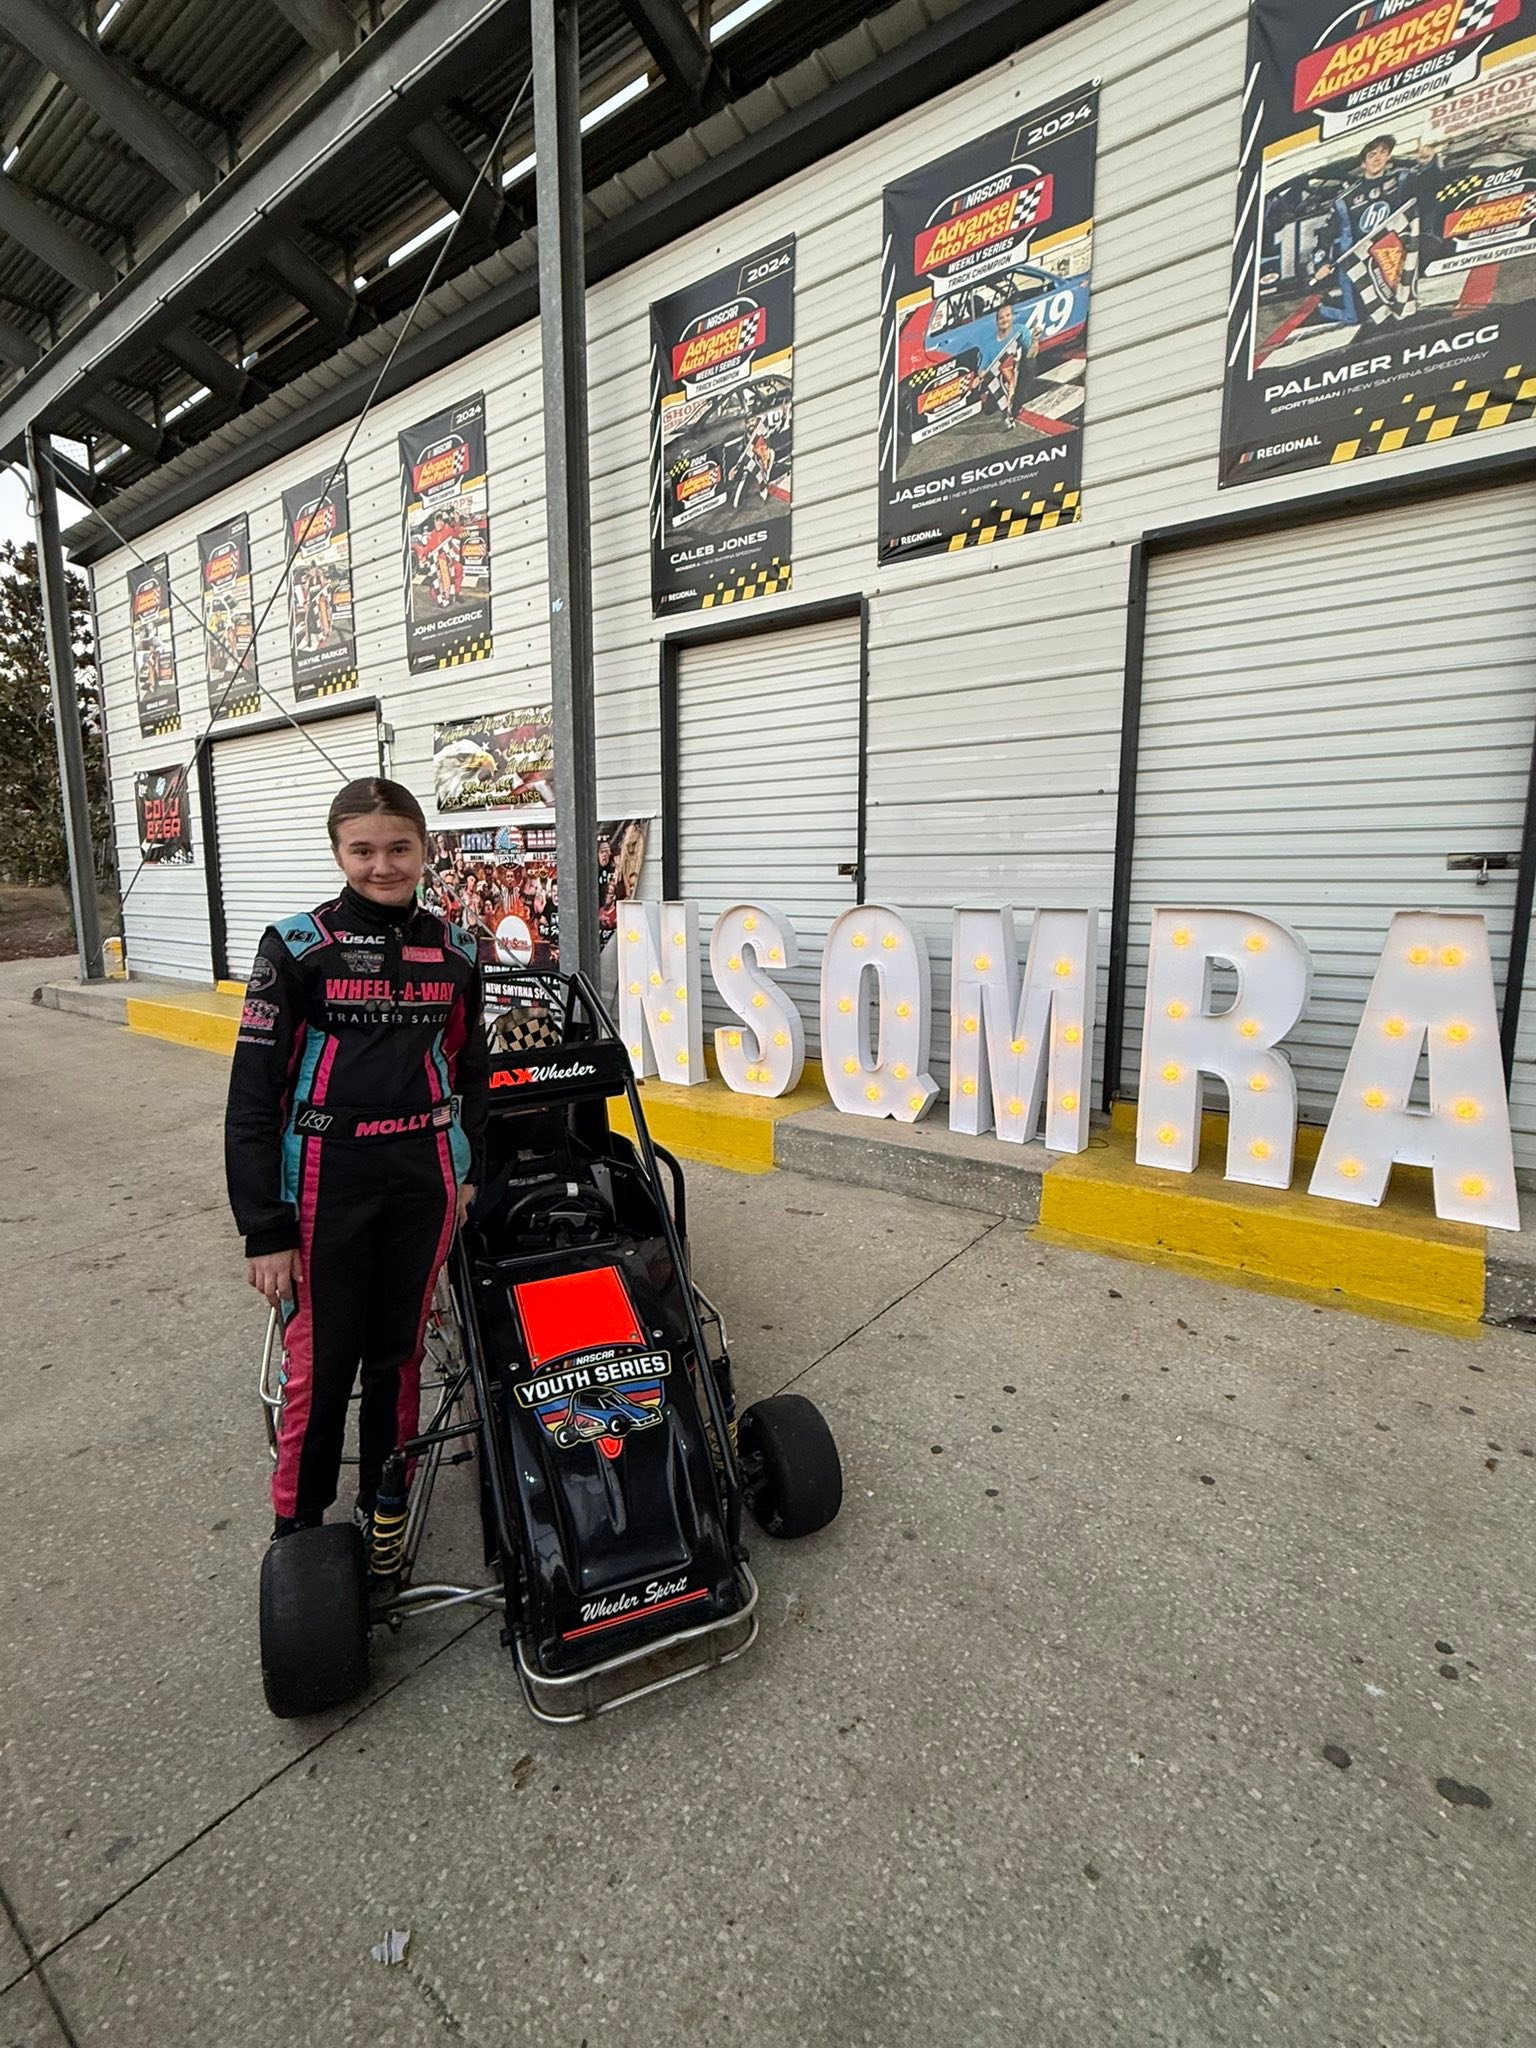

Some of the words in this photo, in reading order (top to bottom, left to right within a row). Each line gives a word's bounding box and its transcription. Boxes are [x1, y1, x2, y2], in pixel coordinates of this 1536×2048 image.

[1322, 3, 1452, 77] Advance
[1305, 63, 1370, 104] Auto
[1370, 29, 1441, 76] Parts
[1346, 74, 1402, 107] WEEKLY
[1402, 50, 1457, 84] SERIES
[1346, 98, 1384, 126] TRACK
[1384, 73, 1452, 110] CHAMPION
[1027, 103, 1092, 146] 2024
[965, 174, 1013, 209] NASCAR
[1483, 166, 1524, 189] 2024
[931, 201, 1009, 250] Advance
[921, 244, 962, 270] Auto
[961, 222, 1006, 252] Parts
[948, 253, 981, 275] WEEKLY
[981, 237, 1014, 259] SERIES
[747, 253, 791, 283] 2024
[947, 273, 971, 289] TRACK
[972, 253, 1013, 280] CHAMPION
[1441, 259, 1459, 270] NEW
[706, 304, 740, 330] NASCAR
[678, 354, 705, 376] Auto
[704, 341, 736, 367] Parts
[684, 325, 737, 360] Advance
[1264, 354, 1392, 403] PALMER
[1402, 324, 1500, 365] HAGG
[1270, 389, 1341, 415] SPORTSMAN
[1347, 382, 1373, 394] NEW
[1373, 369, 1424, 388] SMYRNA
[1424, 350, 1490, 374] SPEEDWAY
[455, 404, 482, 424] 2024
[1256, 434, 1322, 460] REGIONAL
[889, 475, 956, 505] JASON
[960, 445, 1068, 485] SKOVRAN
[911, 497, 942, 510] BOMBER
[670, 544, 715, 565] CALEB
[717, 530, 768, 553] JONES
[901, 528, 943, 546] REGIONAL
[668, 589, 698, 602] REGIONAL
[412, 622, 436, 637] JOHN
[437, 609, 483, 629] DeGEORGE
[521, 791, 541, 803] NSB
[342, 935, 386, 945] USAC
[485, 982, 501, 995] NEW
[502, 983, 533, 999] SMYRNA
[326, 1012, 403, 1024] TRAILER
[489, 1067, 534, 1089] AX
[530, 1061, 597, 1082] Wheeler
[298, 1109, 334, 1132] K1
[354, 1112, 432, 1138] MOLLY
[575, 1349, 615, 1366] NASCAR
[521, 1370, 591, 1403] YOUTH
[594, 1356, 667, 1383] SERIES
[580, 1593, 640, 1623] Wheeler
[643, 1576, 688, 1605] Spirit
